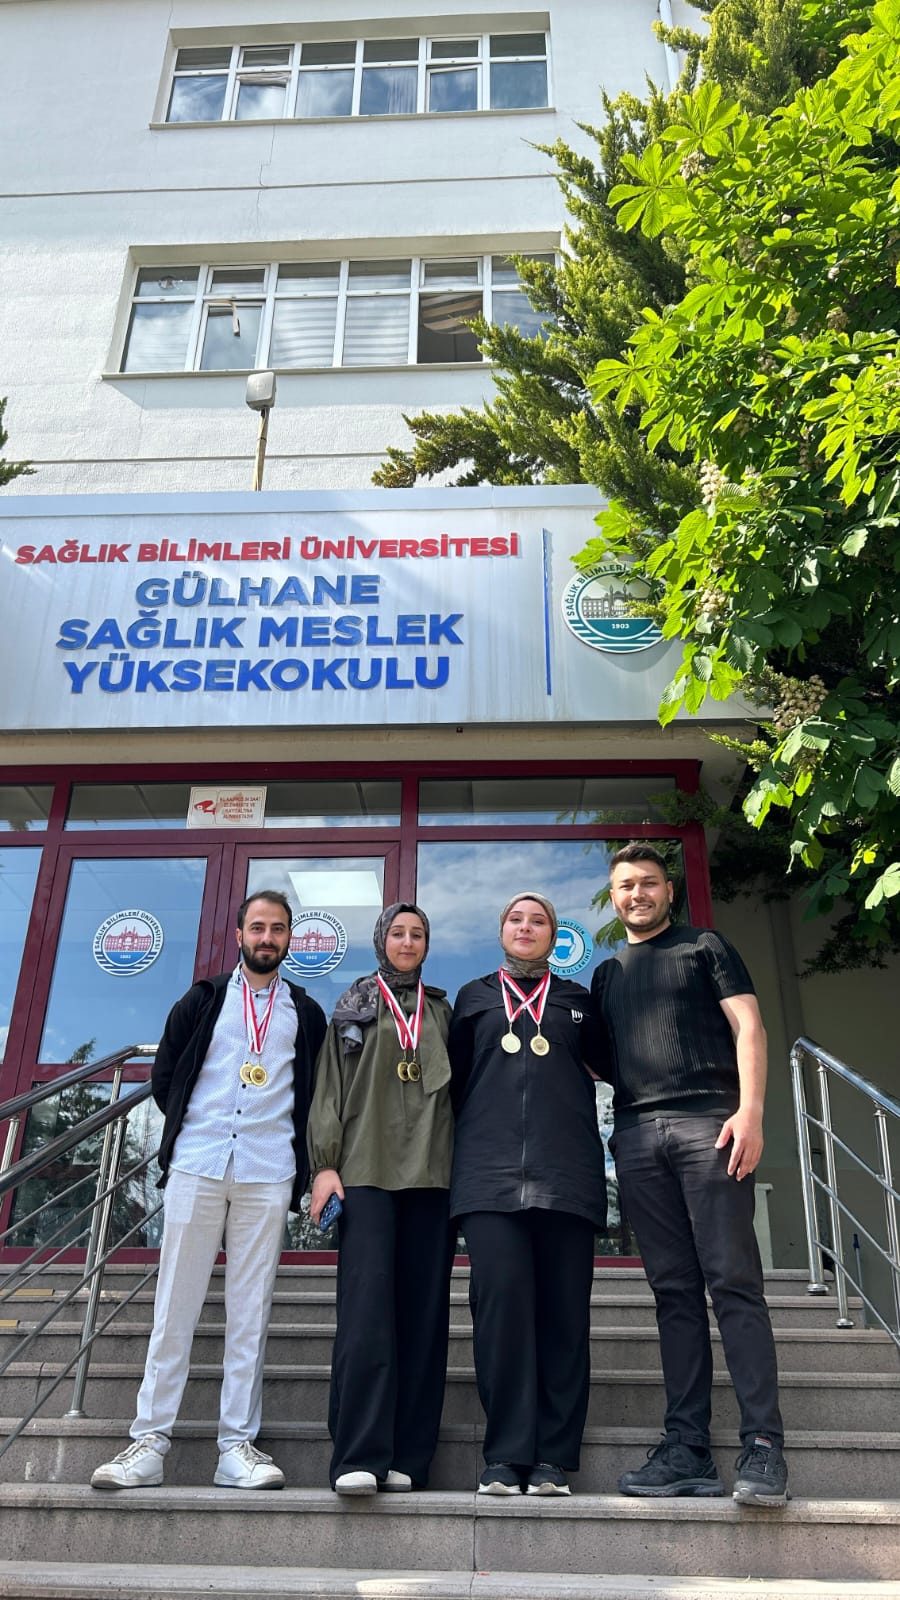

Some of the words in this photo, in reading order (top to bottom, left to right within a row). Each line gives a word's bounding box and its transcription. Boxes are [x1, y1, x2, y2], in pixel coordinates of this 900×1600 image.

[15, 539, 132, 564] SAĞLIK
[137, 537, 291, 562] BİLİMLERİ
[301, 532, 518, 560] ÜNİVERSİTESİ
[135, 570, 380, 607] GÜLHANE
[566, 583, 580, 617] SAĞLIK
[55, 610, 247, 650] SAĞLIK
[258, 613, 464, 648] MESLEK
[63, 653, 450, 694] YÜKSEKOKULU
